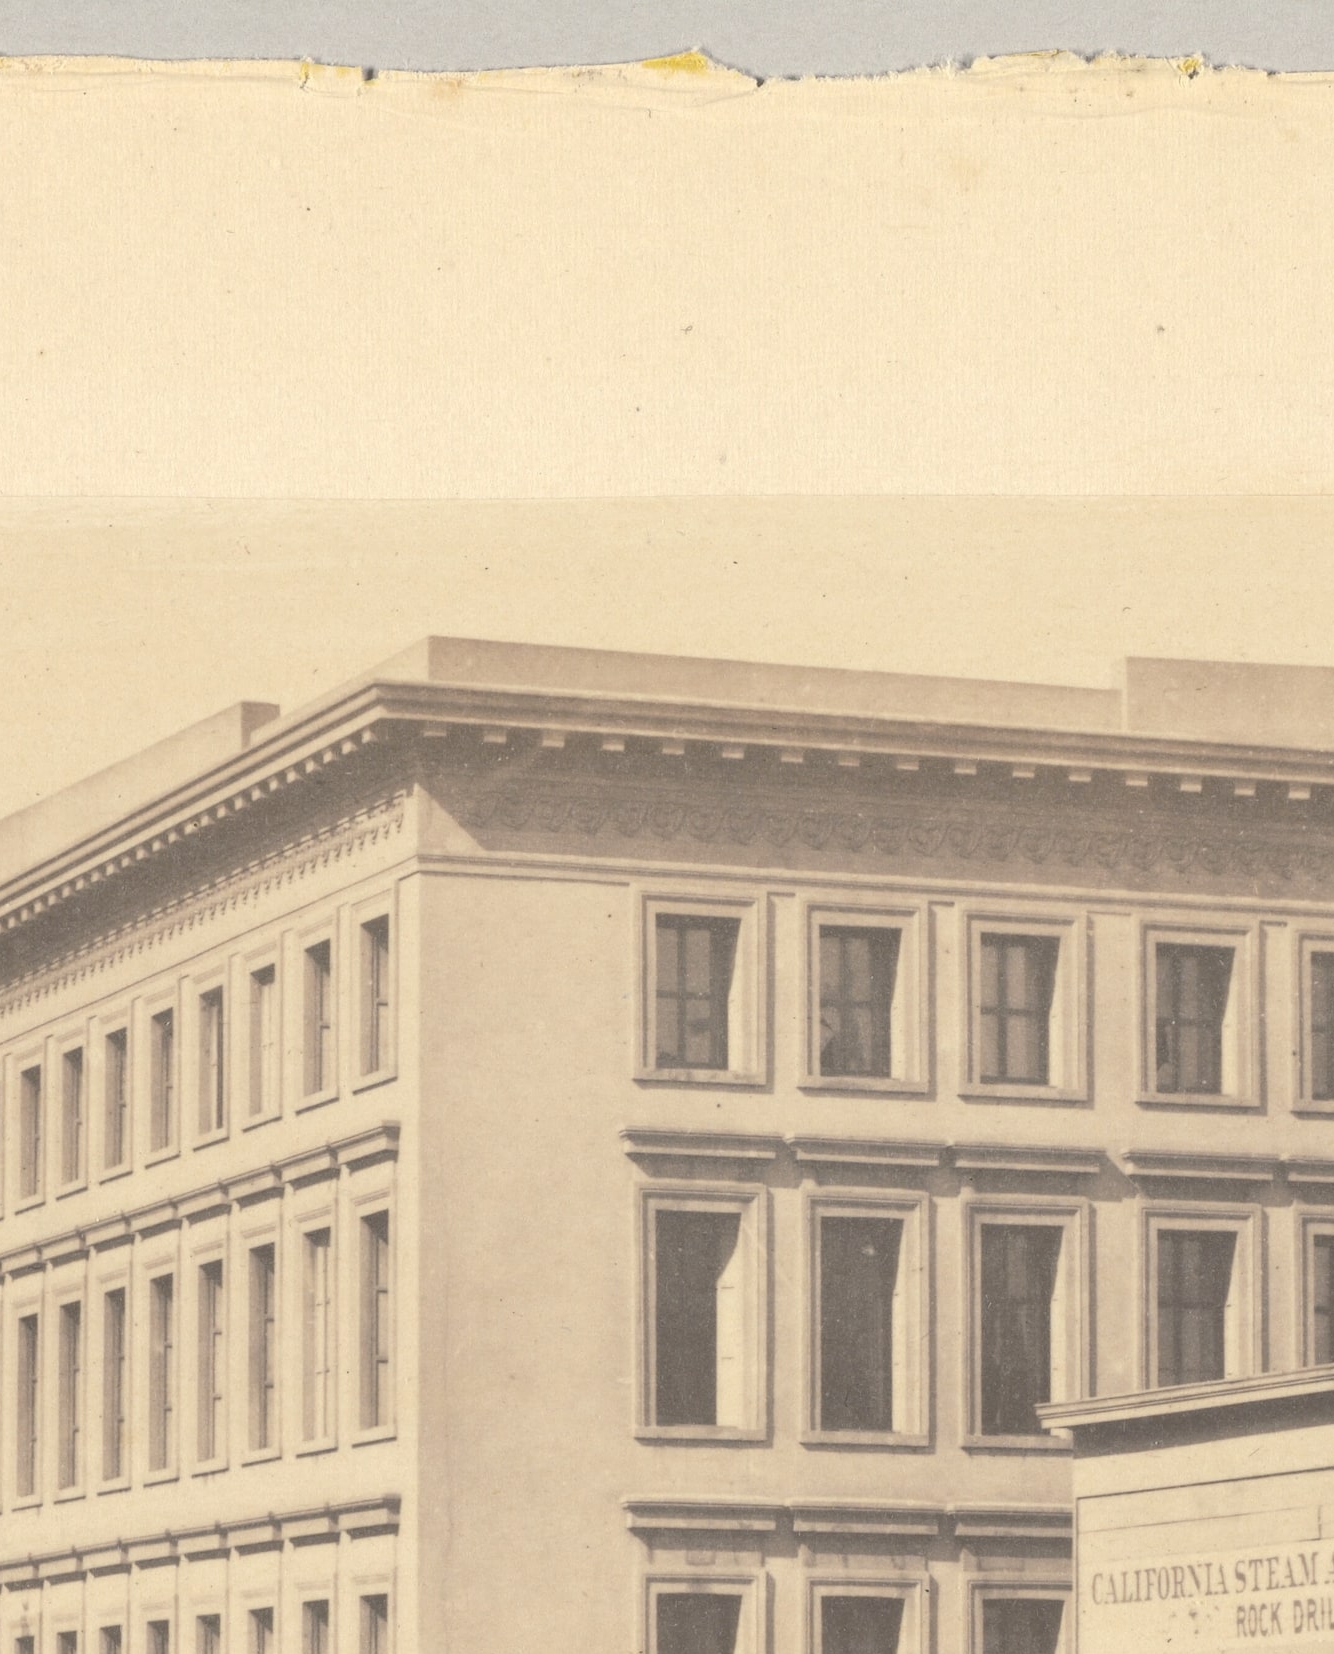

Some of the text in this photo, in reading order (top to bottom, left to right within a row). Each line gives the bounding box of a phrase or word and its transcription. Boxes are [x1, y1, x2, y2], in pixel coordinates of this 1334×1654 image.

[1092, 1562, 1229, 1605] CALIFORNIA
[1234, 1551, 1317, 1594] STEAM
[1236, 1601, 1283, 1638] ROCK
